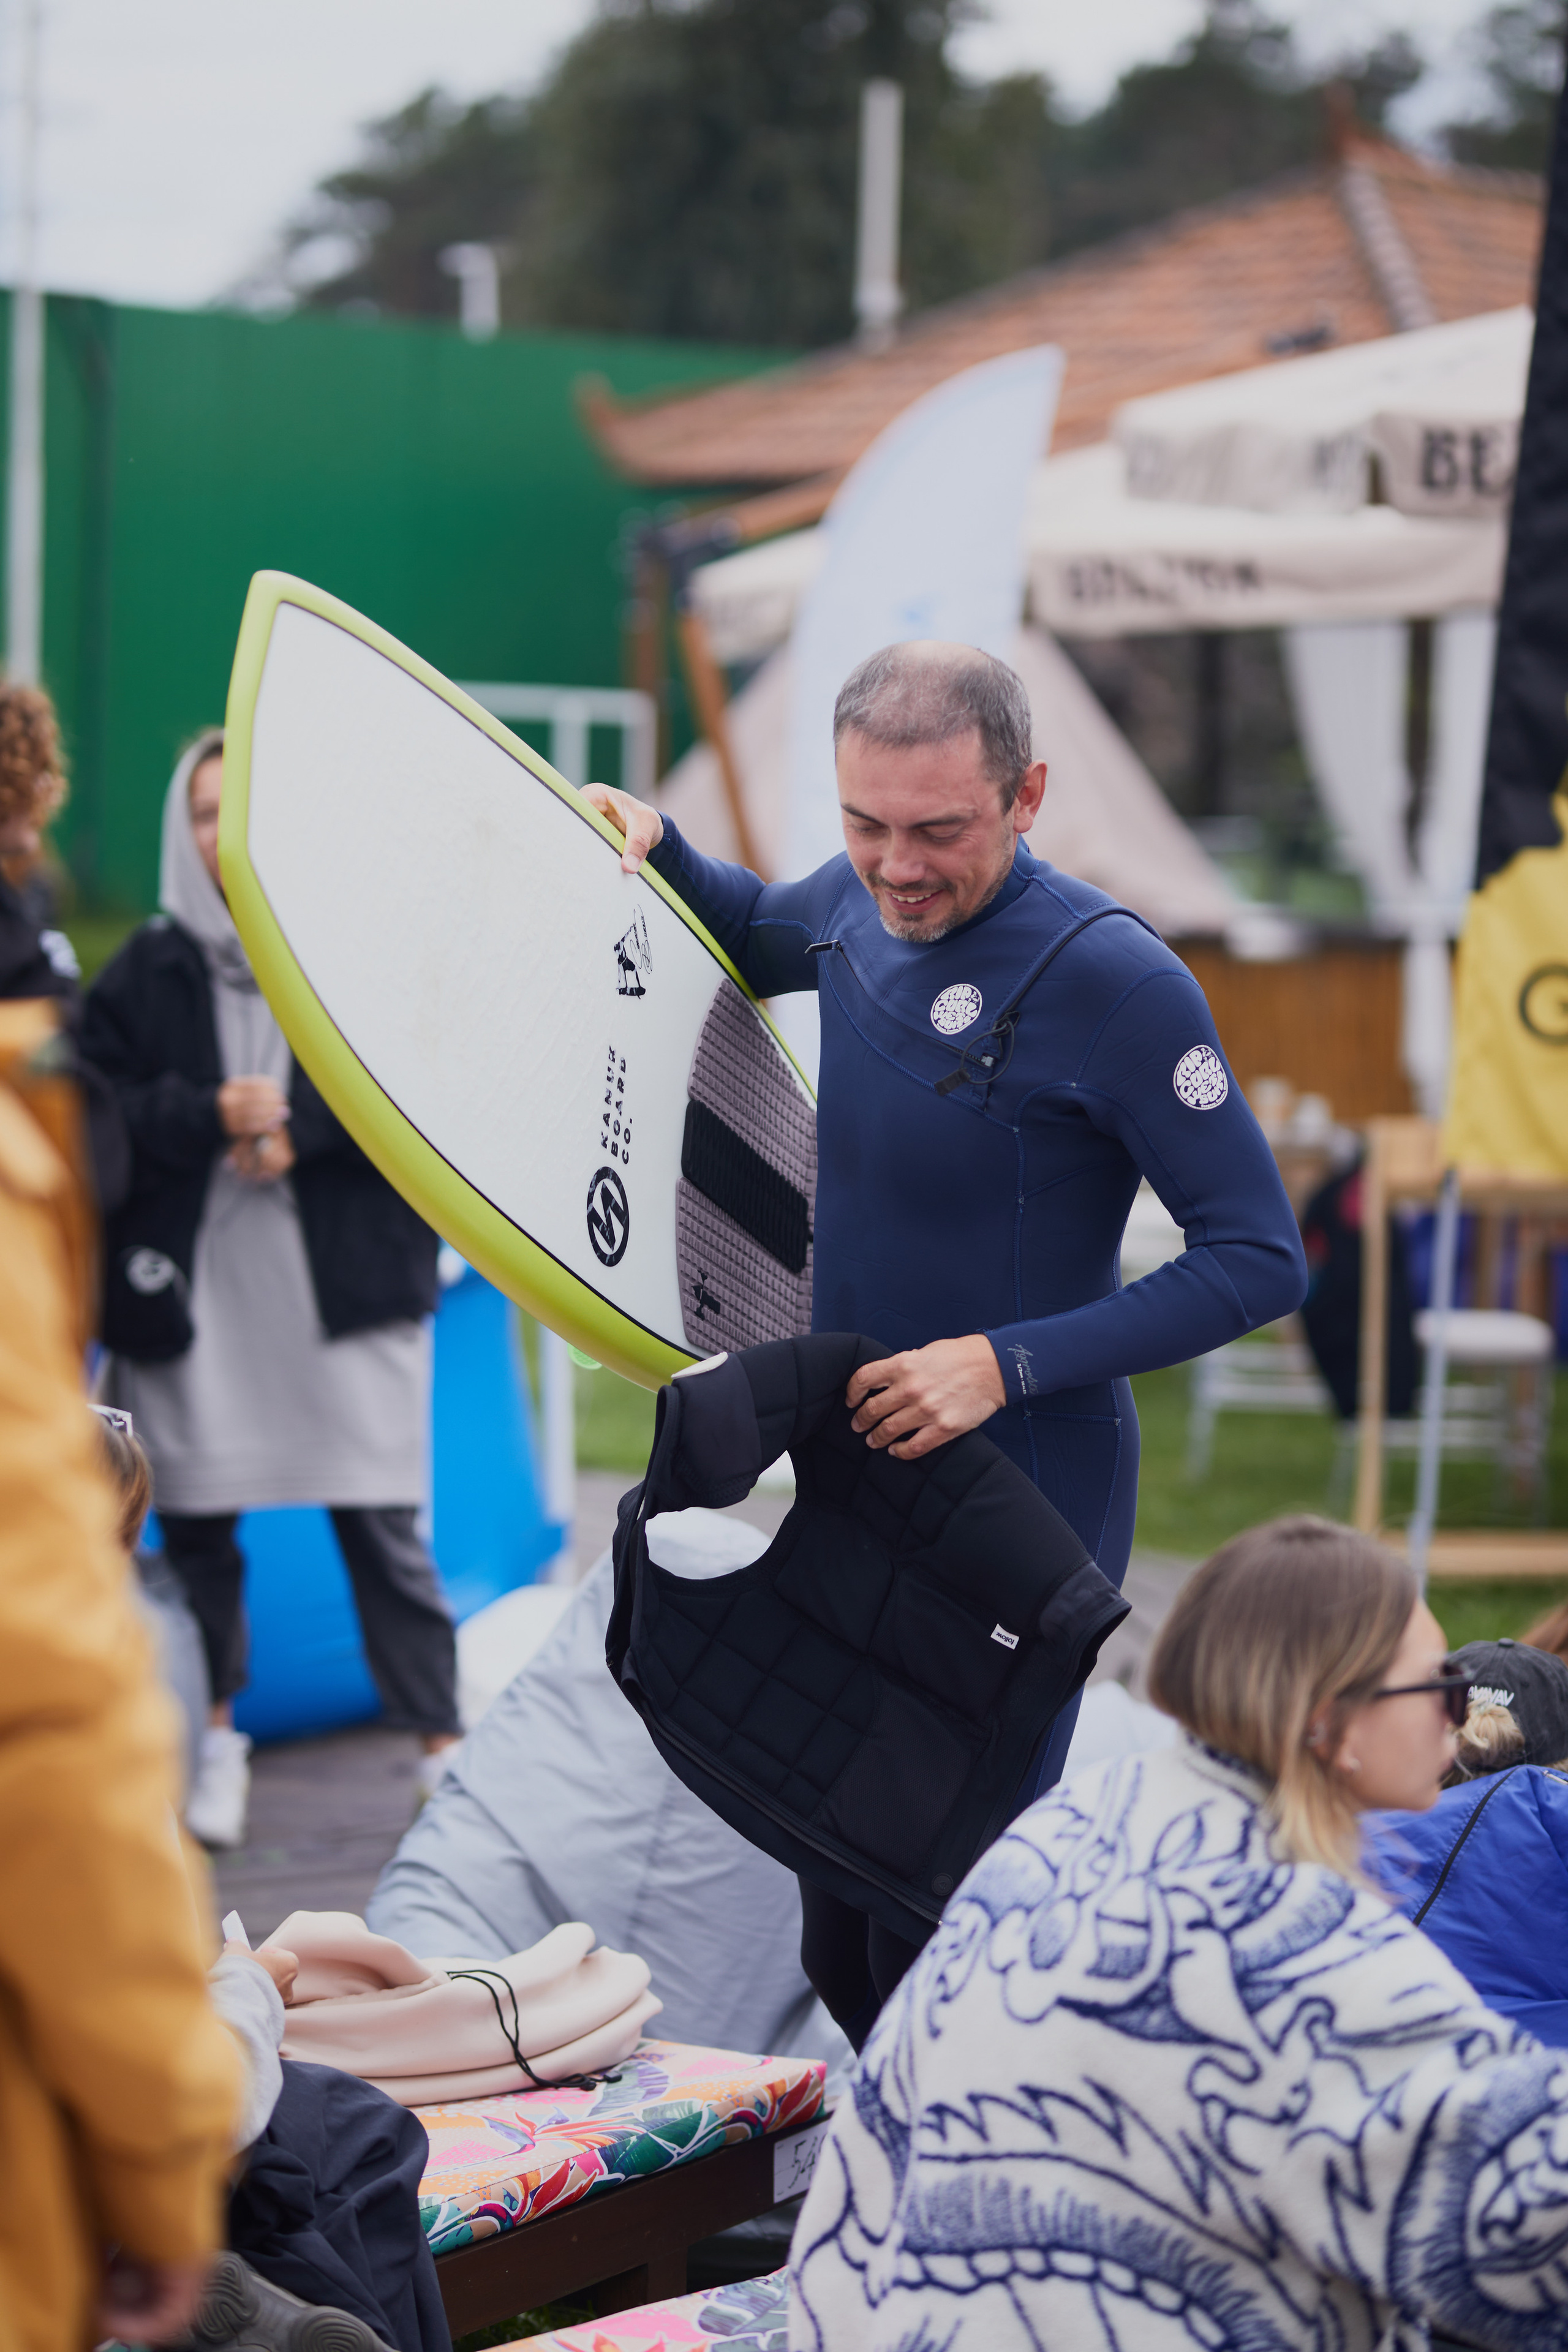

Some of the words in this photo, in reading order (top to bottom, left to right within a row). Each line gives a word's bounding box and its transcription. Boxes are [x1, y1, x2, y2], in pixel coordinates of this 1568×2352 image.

[934, 1000, 978, 1017] CURL
[940, 986, 972, 1000] RIP
[1177, 1050, 1202, 1087] RIP
[1180, 1057, 1221, 1099] CURL
[600, 1045, 616, 1149] KANUK
[611, 1057, 627, 1158] BOARD
[622, 1118, 633, 1165] CO.
